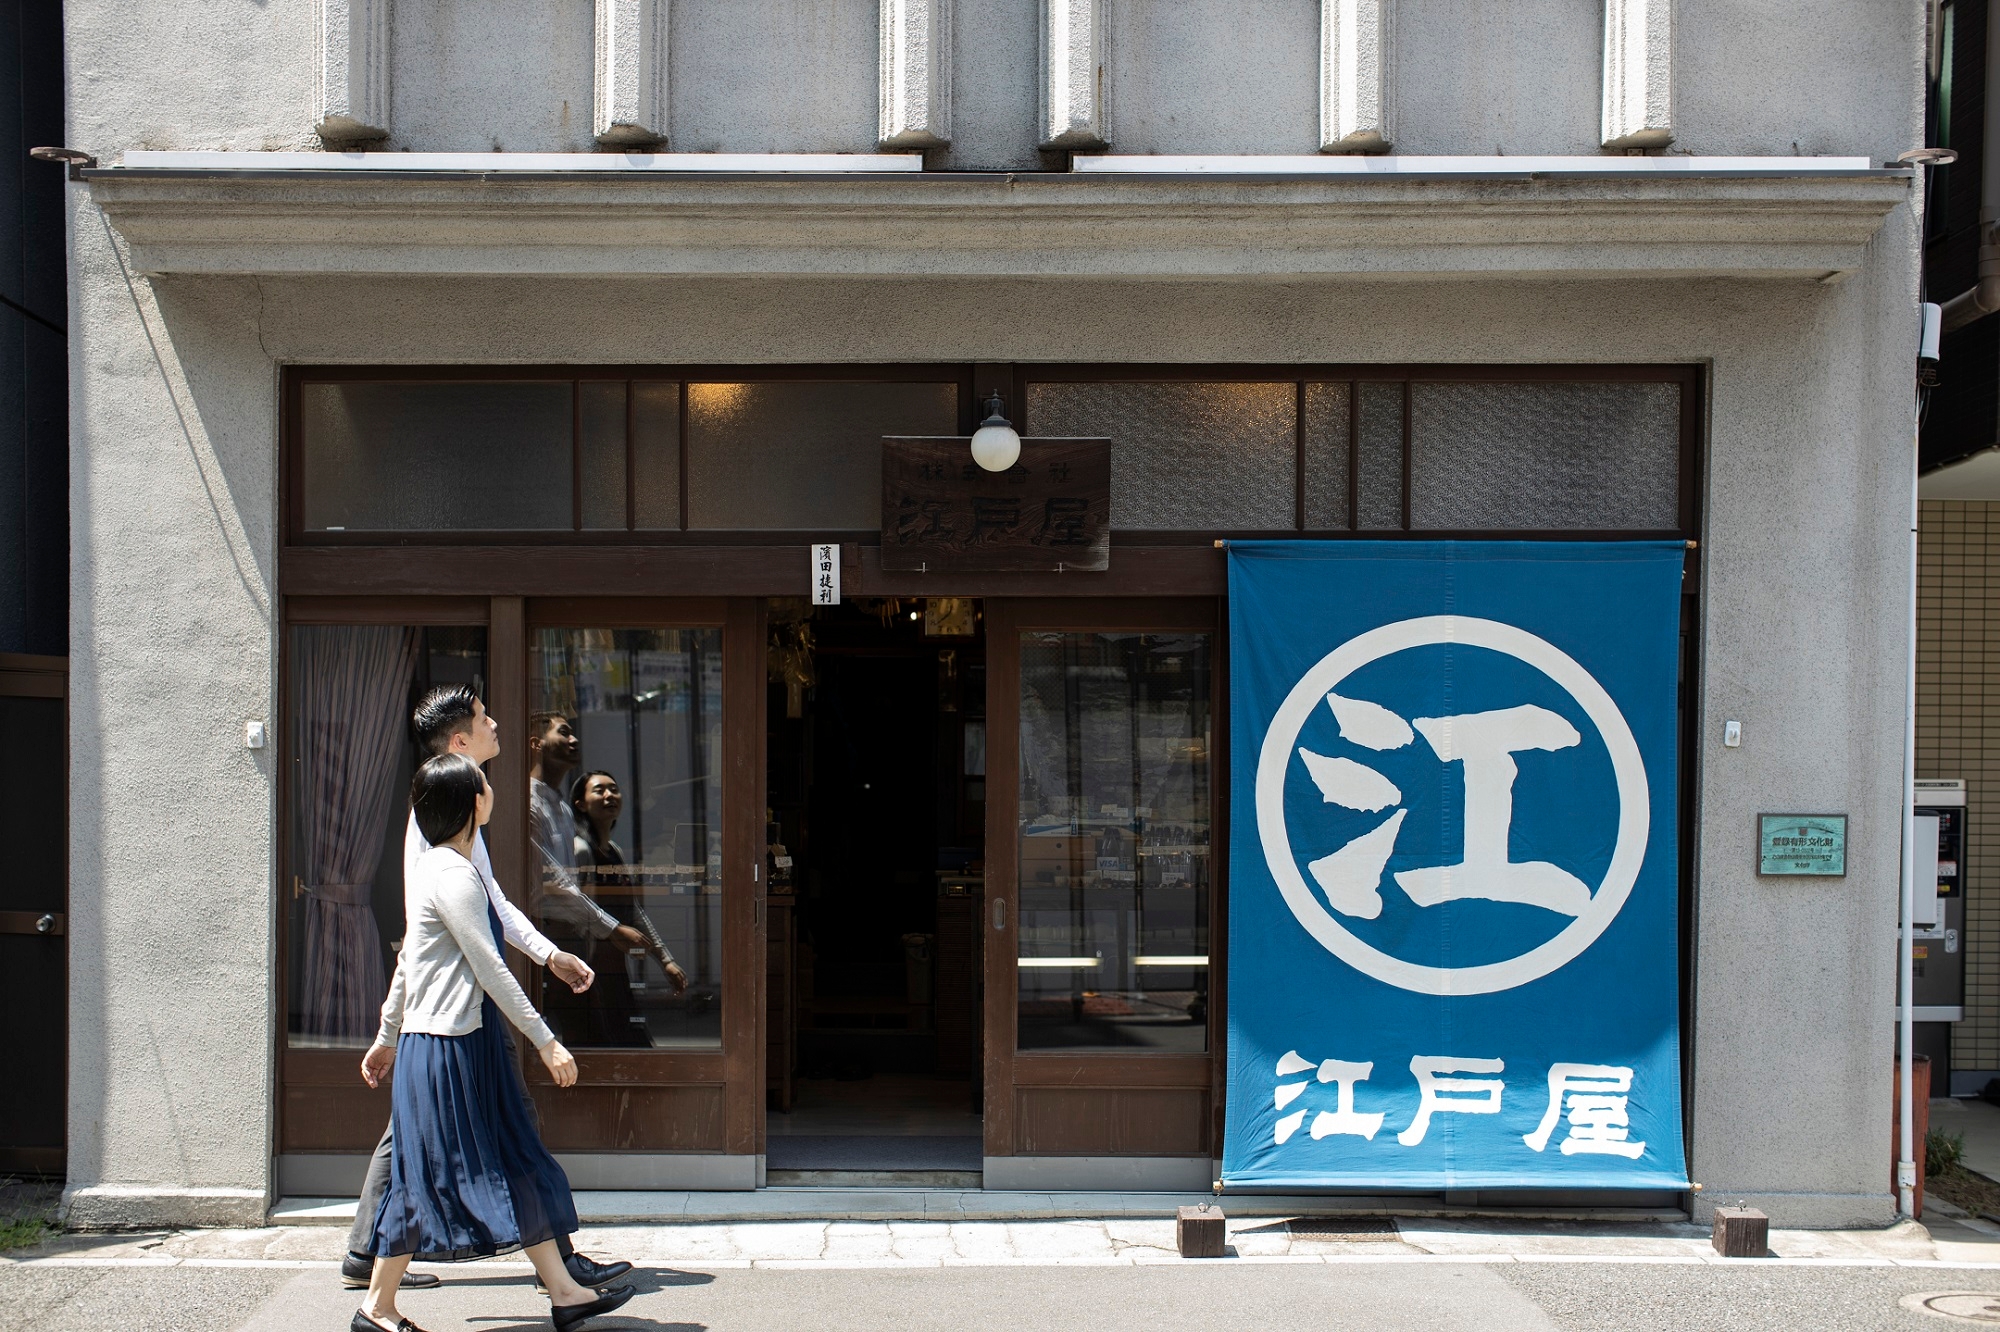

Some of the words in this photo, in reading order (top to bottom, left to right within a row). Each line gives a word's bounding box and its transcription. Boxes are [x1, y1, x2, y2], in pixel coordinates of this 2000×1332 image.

[899, 496, 1092, 547] 江戸屋
[1298, 692, 1592, 919] 江
[1098, 860, 1118, 868] VISA
[1275, 1050, 1646, 1160] 江戸屋
